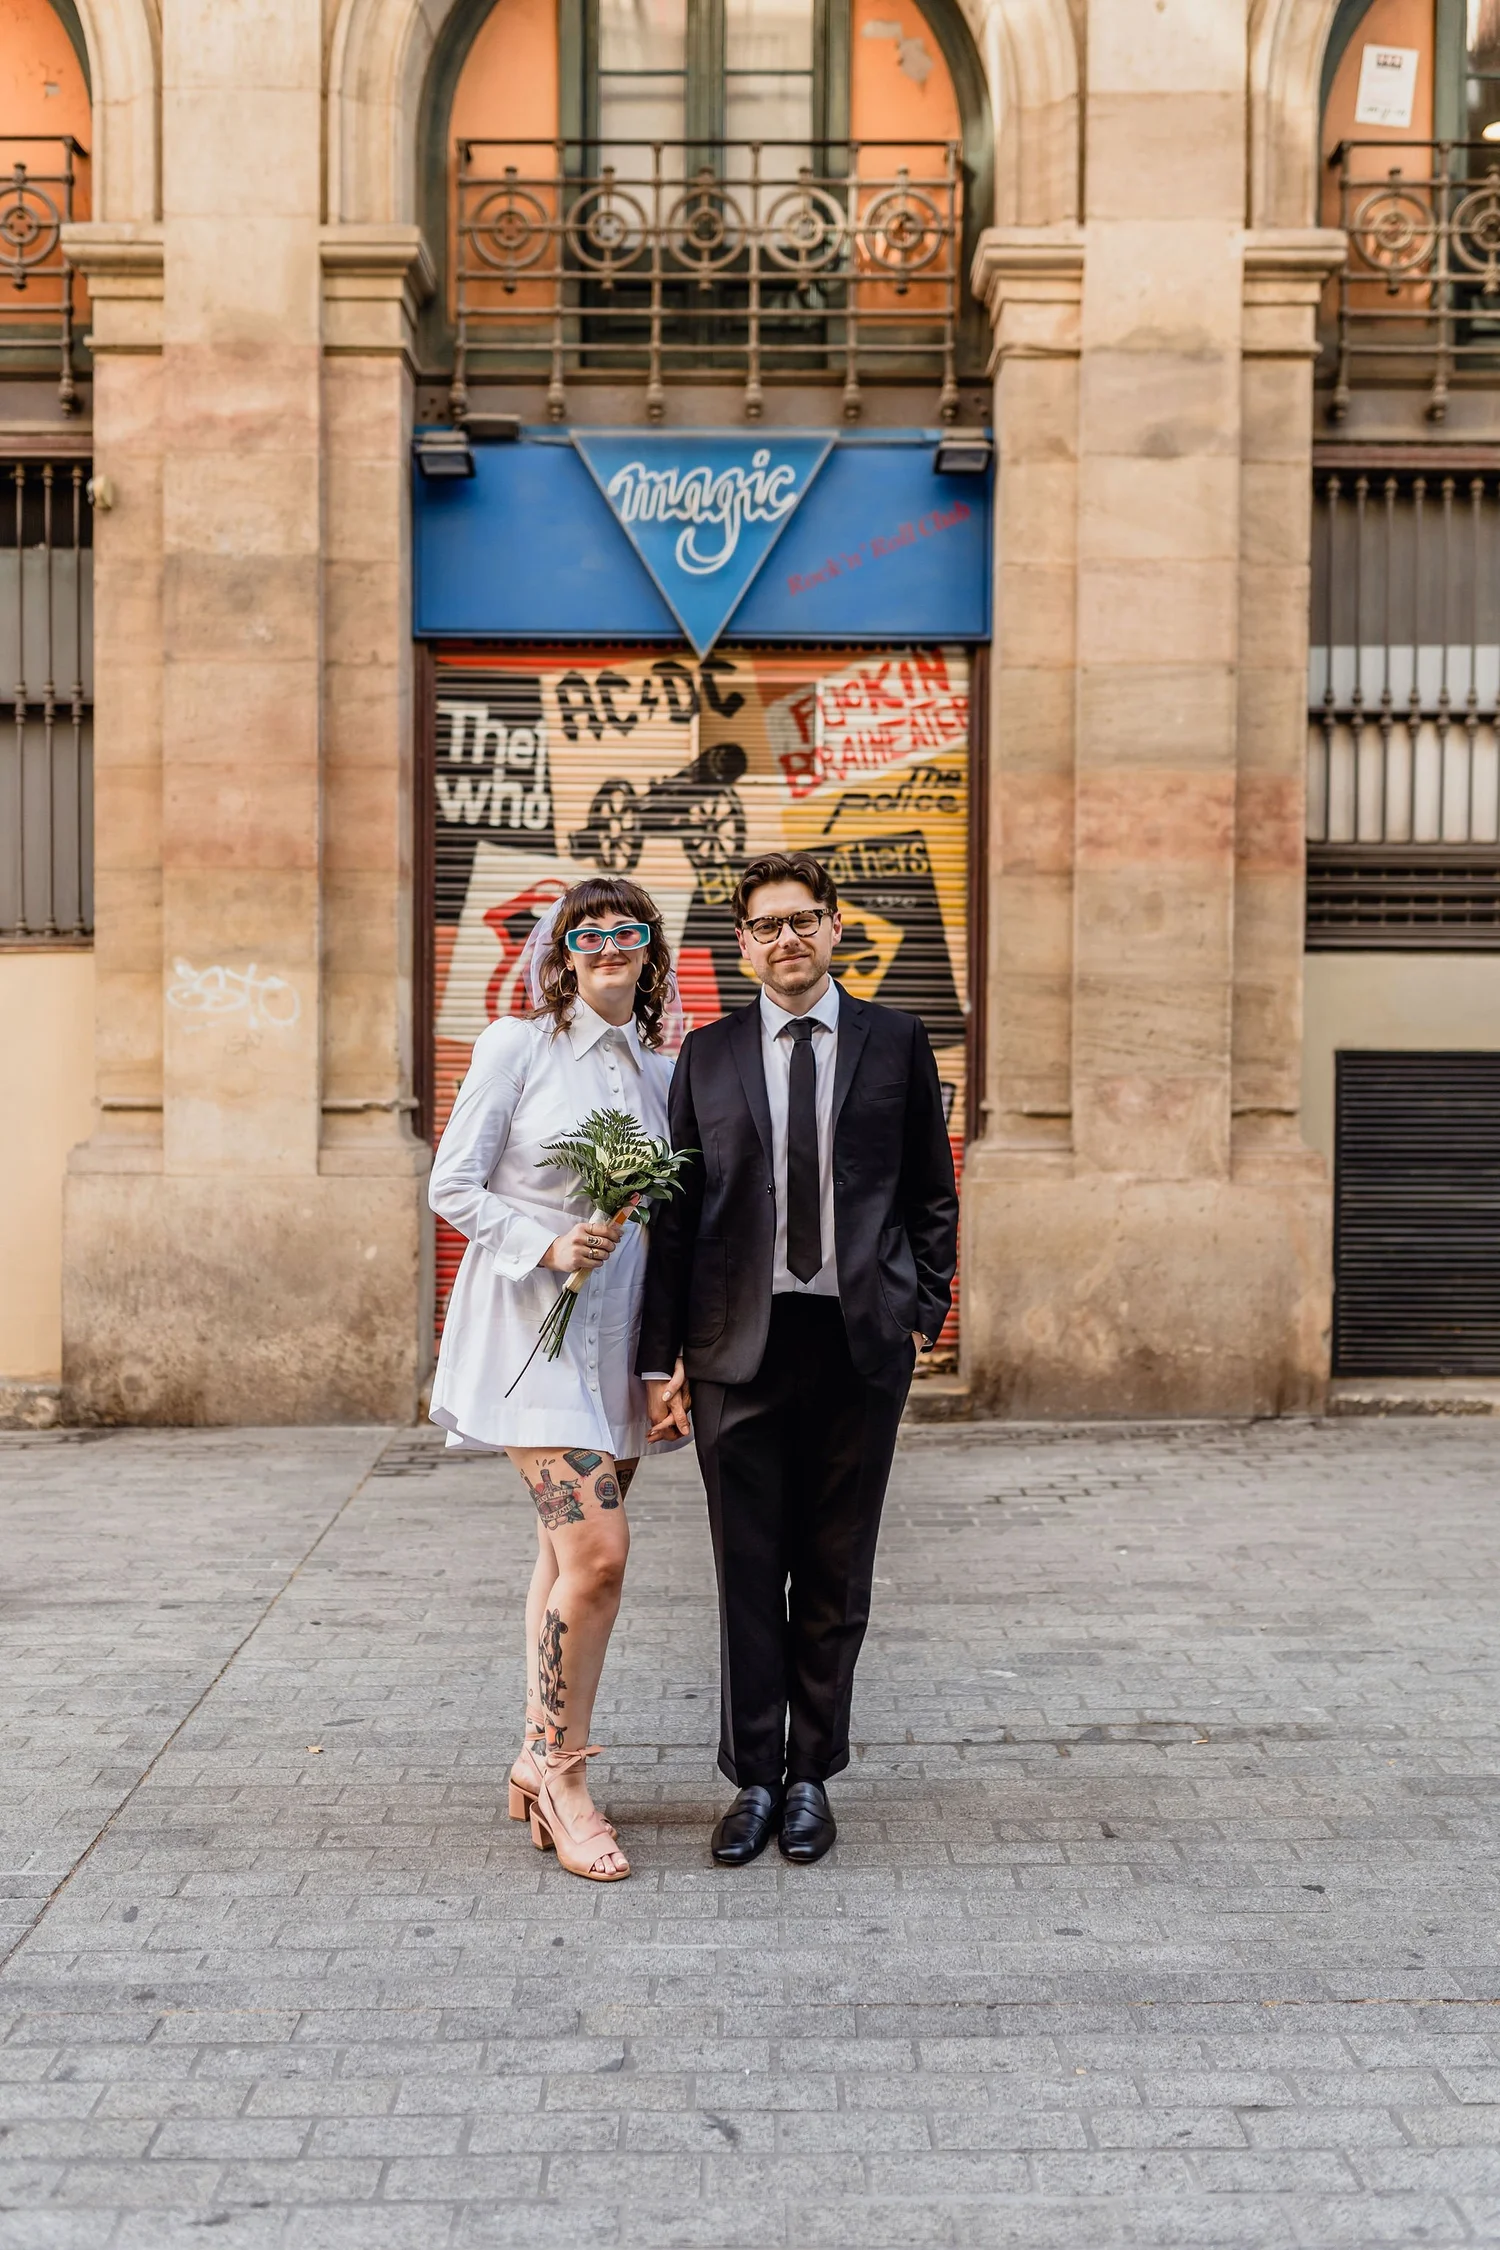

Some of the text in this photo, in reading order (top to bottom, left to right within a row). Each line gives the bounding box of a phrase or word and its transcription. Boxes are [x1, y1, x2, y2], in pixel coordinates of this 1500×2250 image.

[608, 448, 798, 575] magic
[870, 521, 917, 560] Roll
[918, 500, 971, 537] Club
